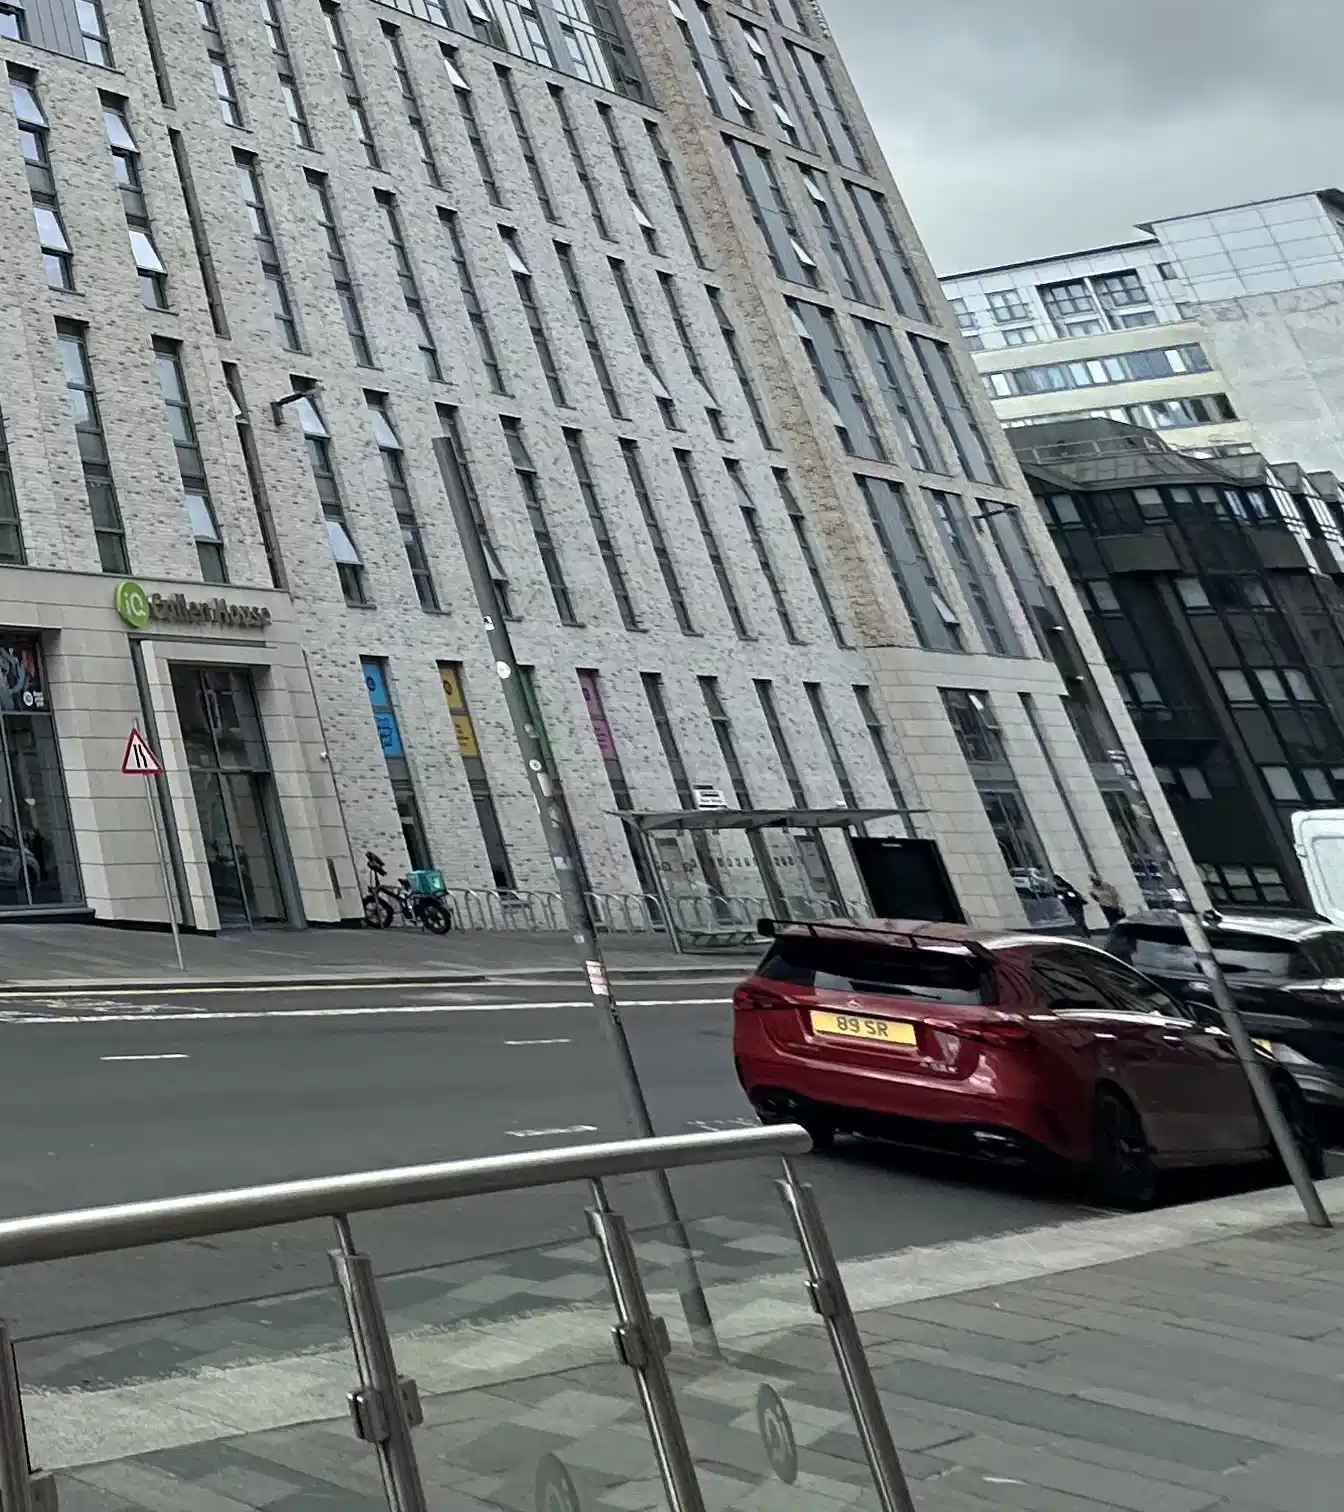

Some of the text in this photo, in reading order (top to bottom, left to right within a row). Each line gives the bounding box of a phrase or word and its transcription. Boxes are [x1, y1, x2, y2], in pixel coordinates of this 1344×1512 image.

[123, 591, 147, 617] iQ
[151, 592, 272, 627] Cullen House
[836, 1016, 889, 1037] 89 SR
